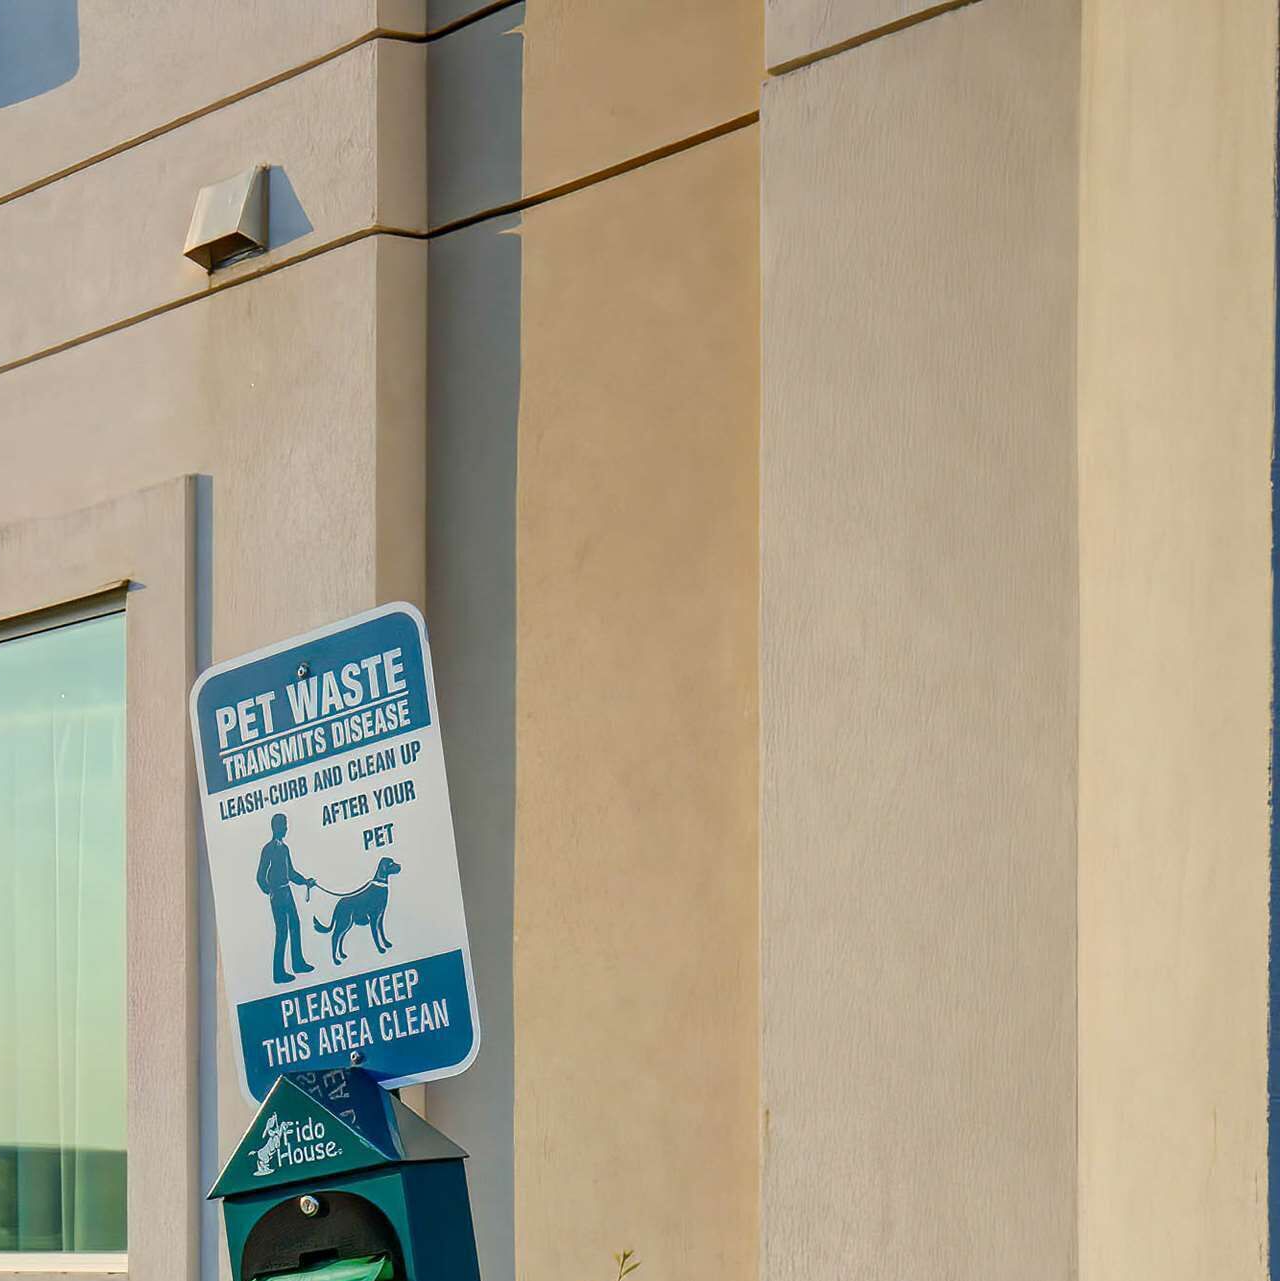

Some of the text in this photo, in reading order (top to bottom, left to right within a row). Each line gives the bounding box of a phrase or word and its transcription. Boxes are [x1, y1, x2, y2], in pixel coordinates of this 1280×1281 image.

[215, 647, 407, 749] PET WASTE
[222, 699, 411, 783] TRANSMITS DISEASE
[219, 740, 422, 821] LEASH-CURB AND CLEAN UP
[322, 779, 416, 827] AFTER YOUR
[362, 823, 395, 851] PET
[281, 968, 420, 1028] PLEASE KEEP
[262, 998, 450, 1068] THIS AREA CLEAN
[277, 1141, 339, 1167] House
[282, 1116, 325, 1146] Fido
